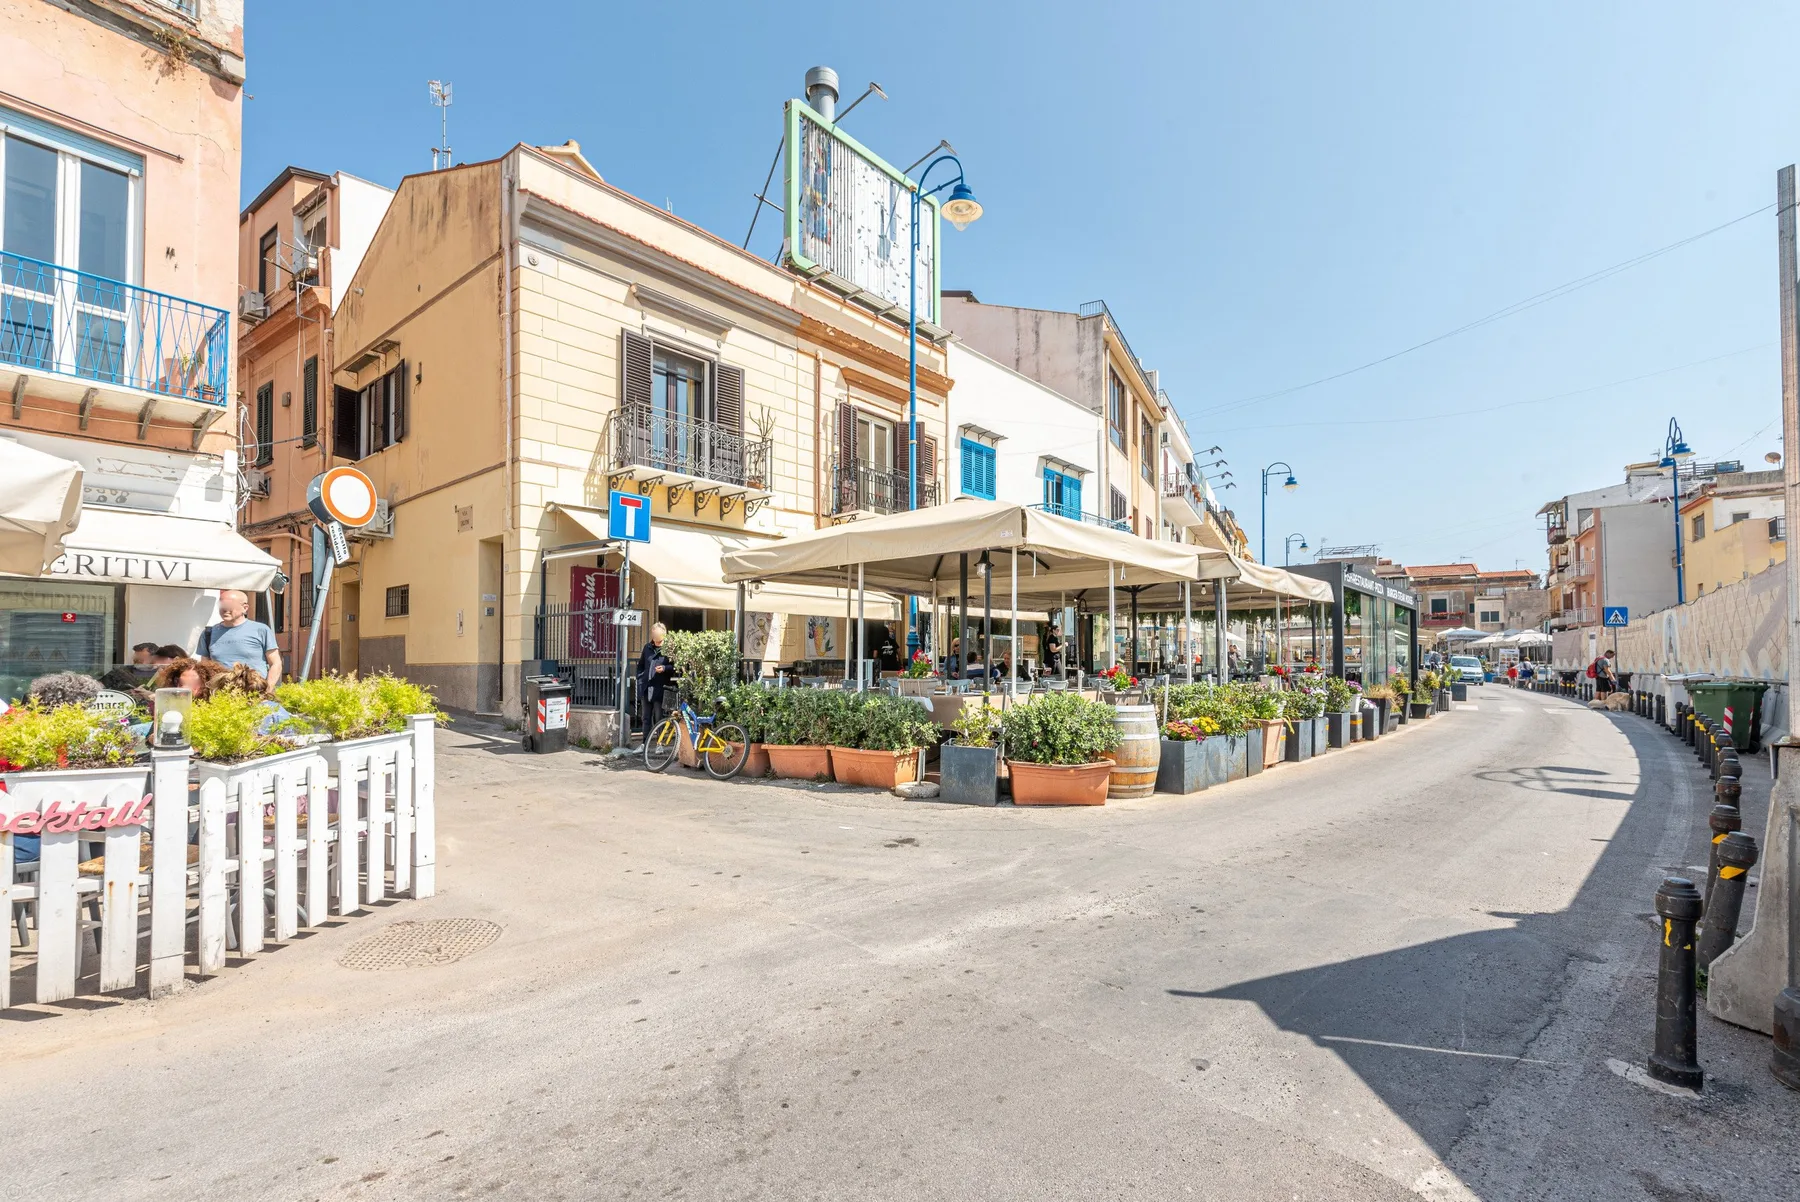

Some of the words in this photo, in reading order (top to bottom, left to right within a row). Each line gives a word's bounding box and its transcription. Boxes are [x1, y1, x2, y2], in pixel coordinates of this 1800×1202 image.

[331, 526, 343, 560] residenti
[619, 613, 637, 621] 0-24
[0, 793, 153, 834] cktail
